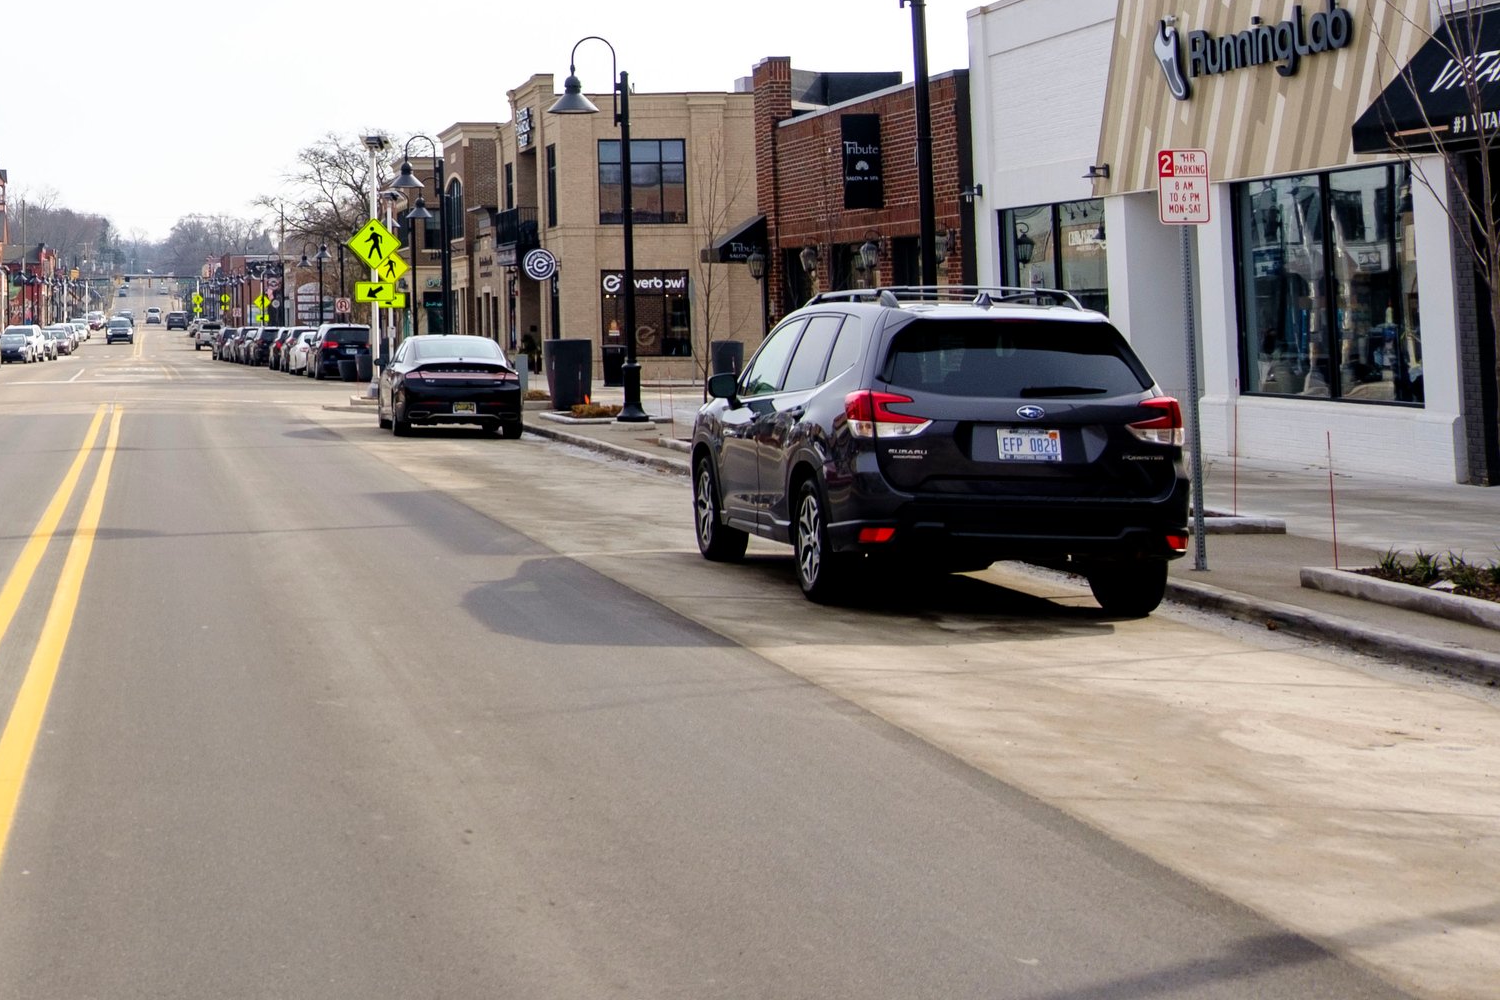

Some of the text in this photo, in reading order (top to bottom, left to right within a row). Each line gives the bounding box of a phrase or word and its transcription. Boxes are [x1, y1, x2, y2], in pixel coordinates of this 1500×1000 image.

[843, 140, 879, 154] Tribute
[1160, 153, 1195, 174] 2 HR
[1175, 164, 1205, 174] PARKING
[1175, 181, 1193, 190] 8 AM
[1170, 193, 1200, 202] TO 6 PM
[1169, 204, 1201, 214] MON-SAT
[634, 276, 685, 289] verbowl
[1003, 437, 1058, 453] EFP 0828
